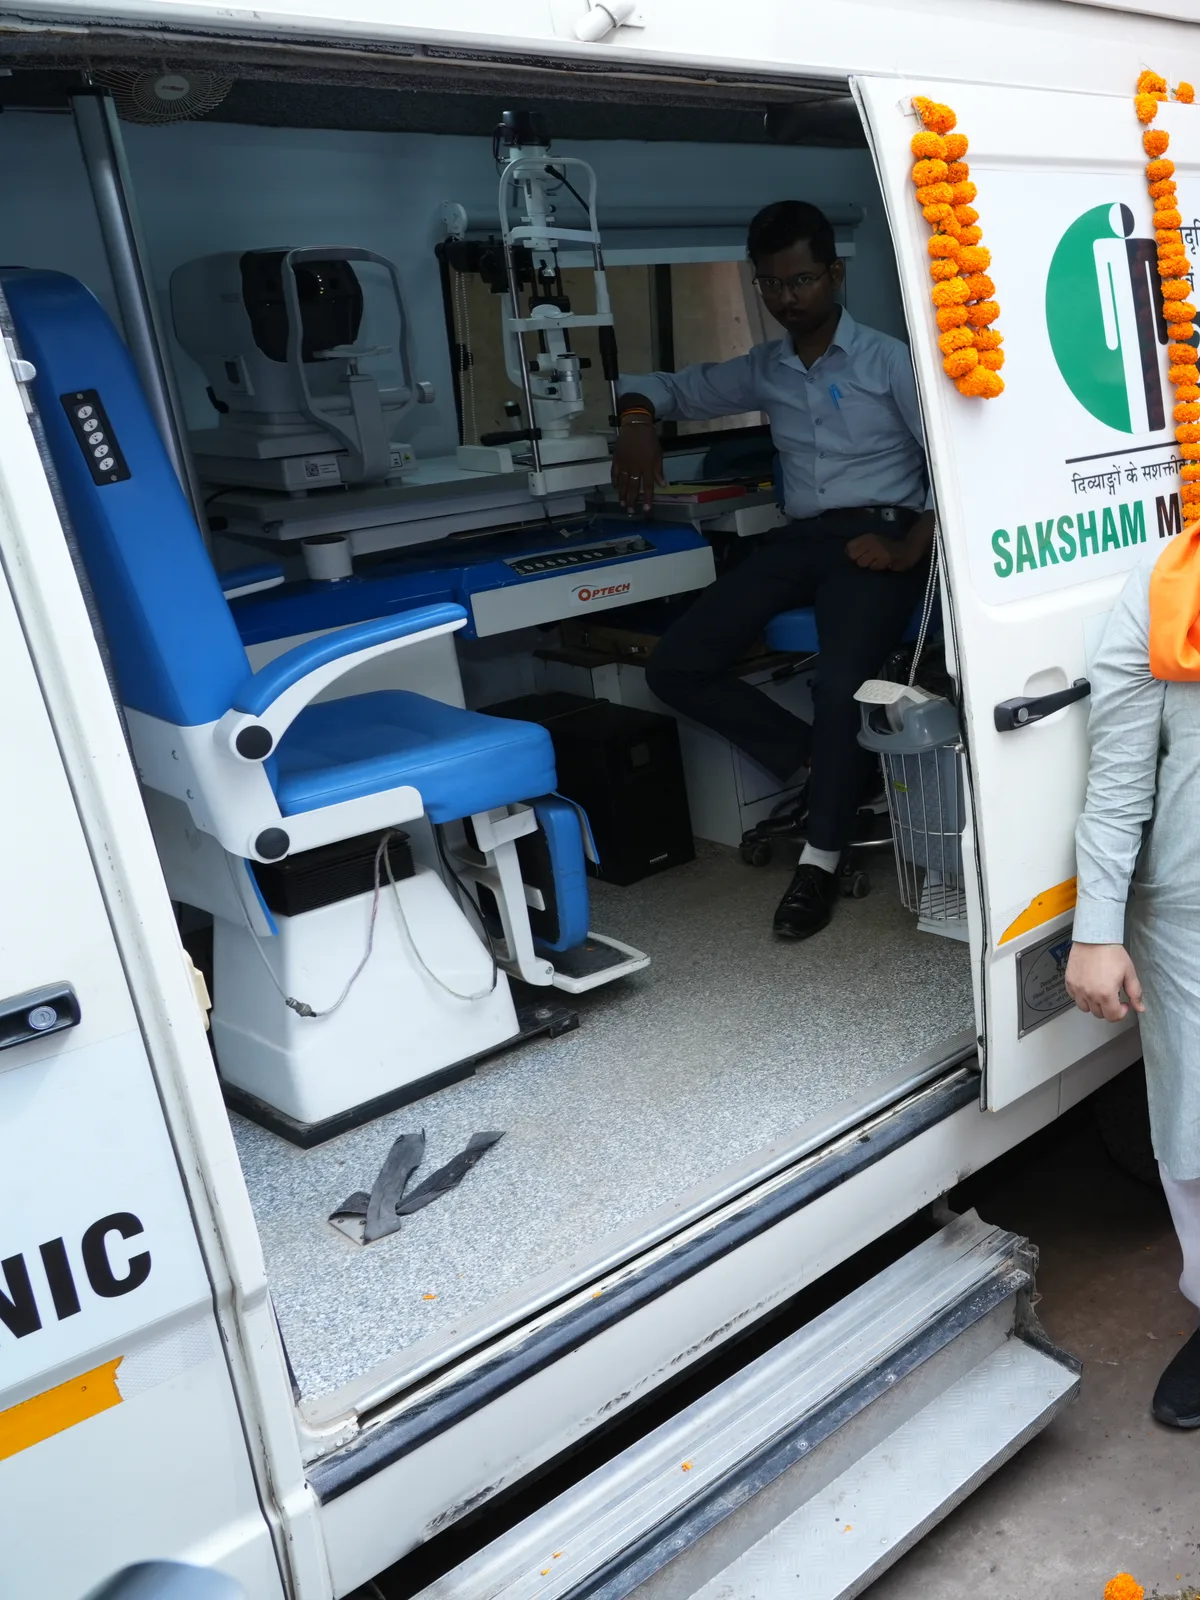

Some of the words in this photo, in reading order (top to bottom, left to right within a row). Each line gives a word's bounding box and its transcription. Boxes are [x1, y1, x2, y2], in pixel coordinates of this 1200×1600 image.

[1125, 461, 1138, 483] के
[991, 500, 1147, 578] SAKSHAM
[578, 582, 631, 602] OPTECH
